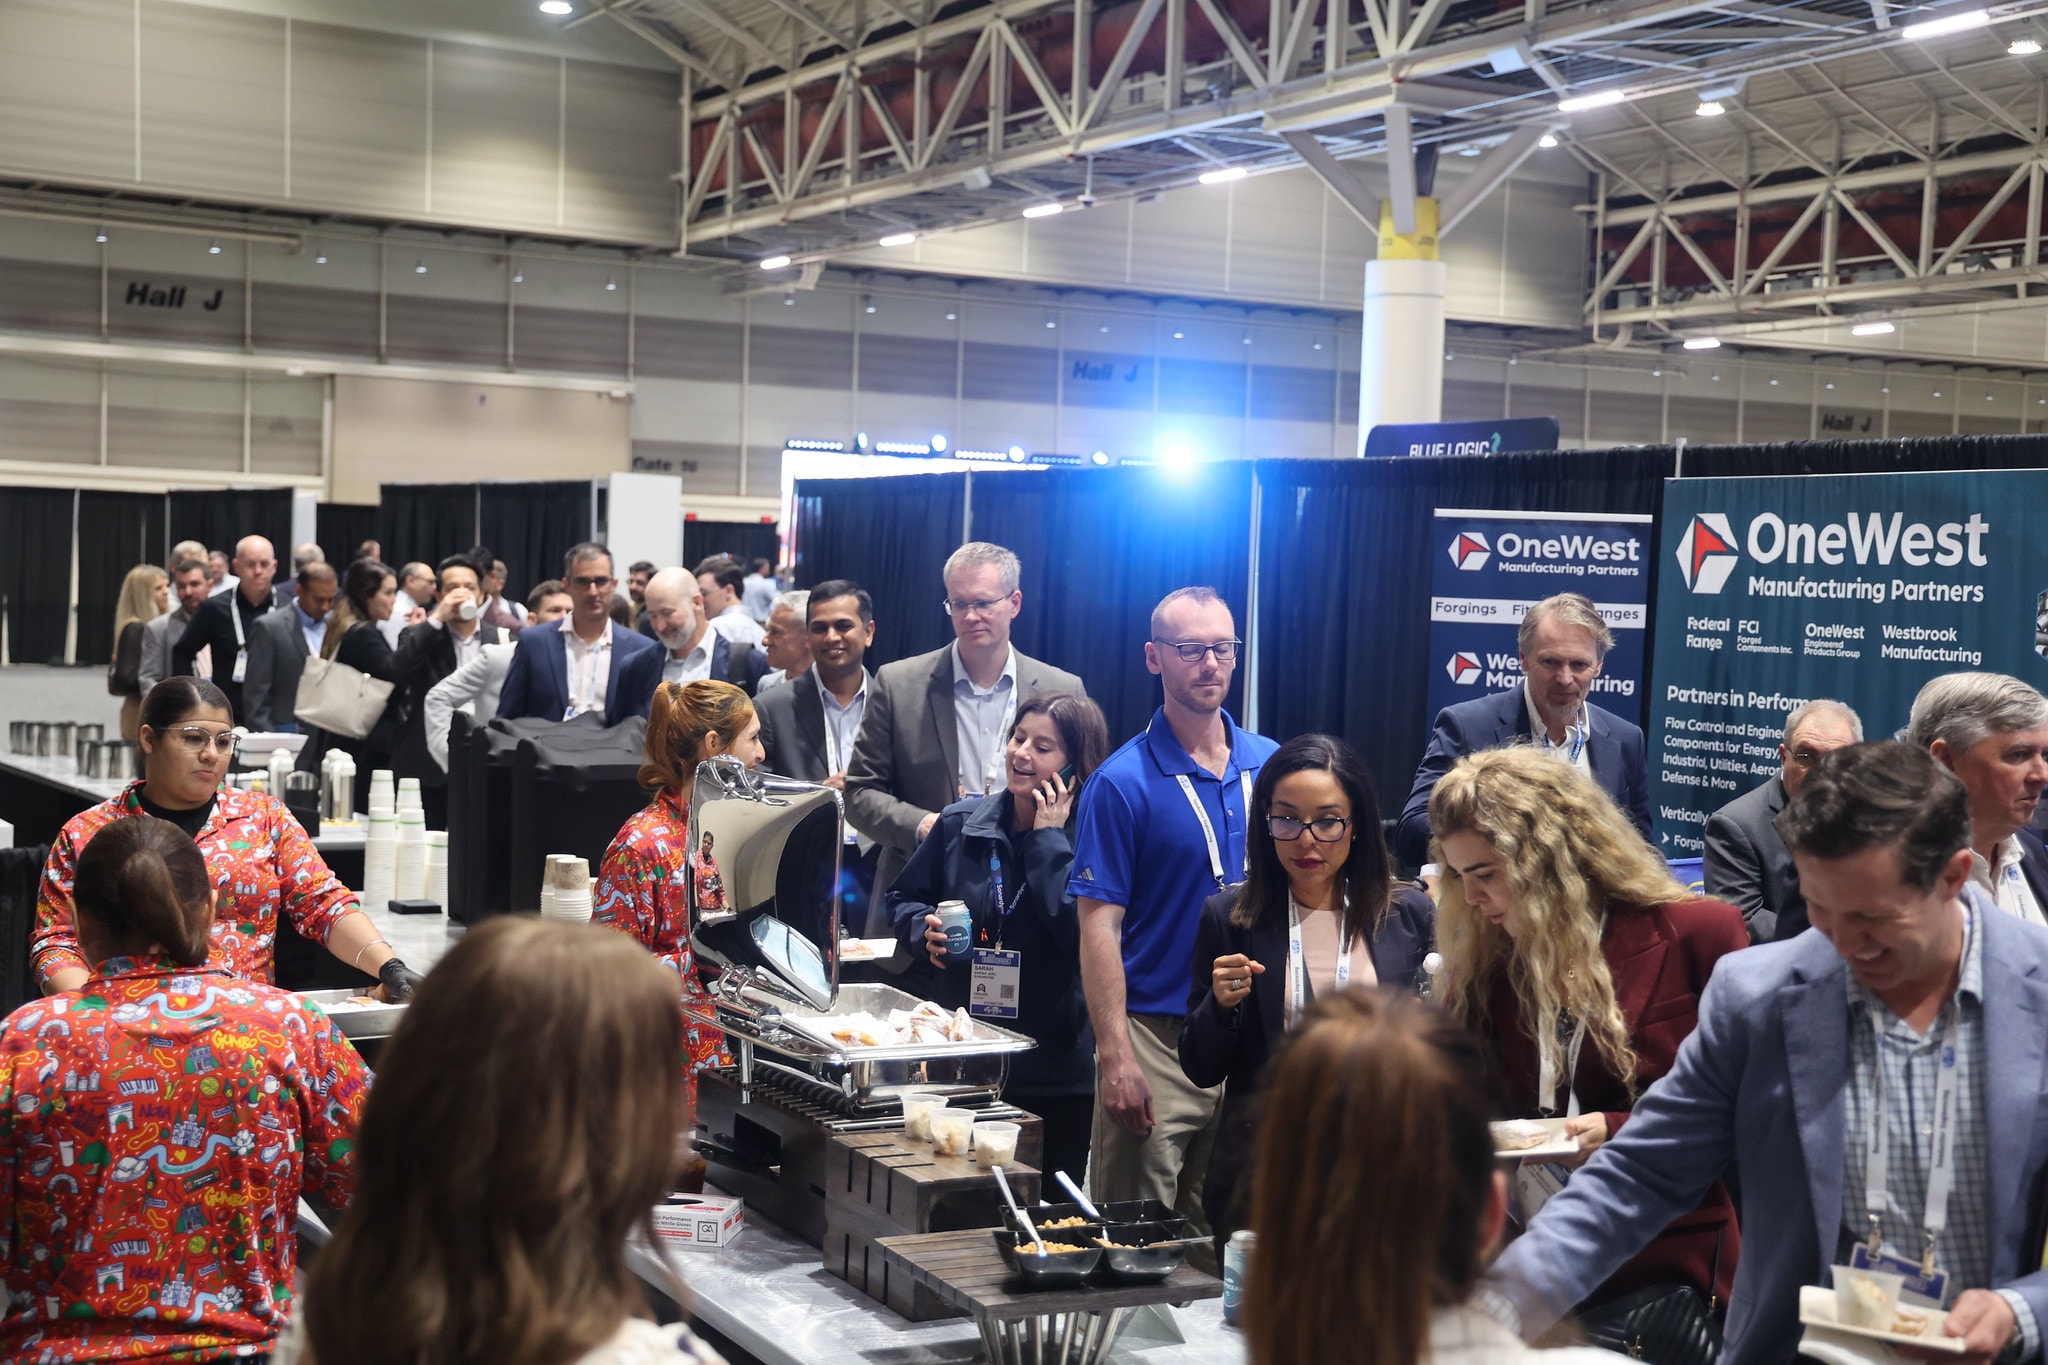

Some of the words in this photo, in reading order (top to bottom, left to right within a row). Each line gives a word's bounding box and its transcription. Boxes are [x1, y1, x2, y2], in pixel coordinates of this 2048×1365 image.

[125, 282, 187, 308] Hall
[204, 289, 223, 311] J
[1072, 362, 1113, 380] Hall
[1125, 363, 1138, 383] J
[1822, 413, 1854, 431] Hall
[1861, 415, 1872, 432] J
[1409, 443, 1446, 457] BLUE
[1447, 441, 1490, 456] LOGIC
[1497, 533, 1640, 561] OneWest
[1747, 511, 1989, 567] OneWest
[1499, 562, 1584, 576] Manufacturing
[1588, 564, 1639, 576] Partners
[1748, 576, 1886, 604] Manufacturing
[1891, 579, 1984, 602] Partners
[1435, 601, 1497, 615] Forgings
[1598, 609, 1639, 621] anges
[1687, 616, 1731, 632] Federal
[1738, 620, 1759, 634] FCI
[1805, 623, 1865, 640] OneWest
[1882, 624, 1958, 642] Westbrook
[1836, 649, 1861, 659] Group
[1881, 644, 1982, 666] Manufacturing
[1667, 685, 1728, 706] Partners
[1730, 689, 1744, 707] in
[1665, 716, 1685, 729] Flow
[1687, 718, 1724, 733] Control
[1725, 724, 1746, 736] and
[1664, 735, 1724, 752] Components
[1725, 740, 1741, 754] for
[1663, 752, 1708, 770] Industrial,
[1710, 758, 1749, 775] Utilities,
[1662, 770, 1701, 786] Defense
[1702, 776, 1709, 787] &
[1711, 776, 1737, 791] More
[1660, 805, 1709, 826] Vertically
[1674, 835, 1704, 851] Forgin
